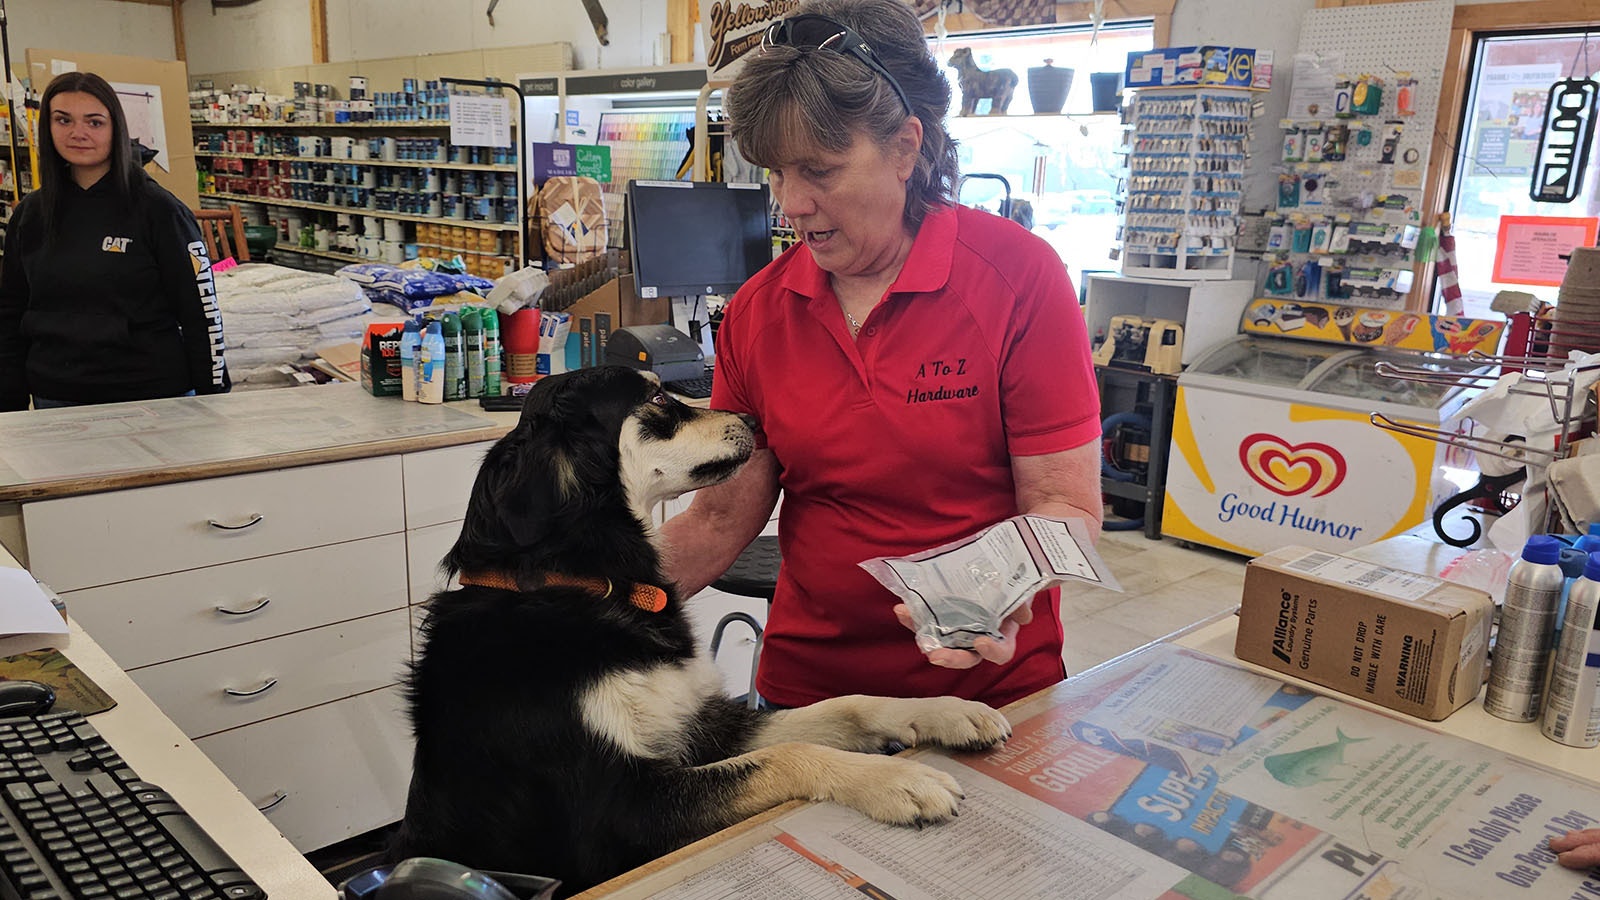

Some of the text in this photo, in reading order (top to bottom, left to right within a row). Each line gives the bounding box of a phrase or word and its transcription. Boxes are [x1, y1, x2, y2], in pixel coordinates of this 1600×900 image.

[730, 38, 748, 56] Form
[620, 77, 657, 89] color gallery
[102, 236, 128, 253] CAT
[187, 240, 226, 385] CATERPILLAR
[915, 359, 966, 379] A To Z
[907, 385, 979, 404] Hardware
[1218, 493, 1362, 541] Good Humor
[1275, 591, 1292, 650] Alliance
[1299, 599, 1317, 670] Genuine Parts
[1350, 621, 1368, 677] DO NOT DROP
[1365, 614, 1387, 694] HANDLE WITH CARE
[1396, 634, 1413, 688] WARNING
[1005, 751, 1054, 776] TOUGH
[1029, 745, 1122, 793] GORILL
[1489, 793, 1542, 824] Please
[1468, 820, 1521, 843] Only
[1443, 851, 1476, 867] I
[1450, 838, 1495, 860] Can
[1495, 865, 1541, 888] One
[1551, 810, 1600, 830] Day
